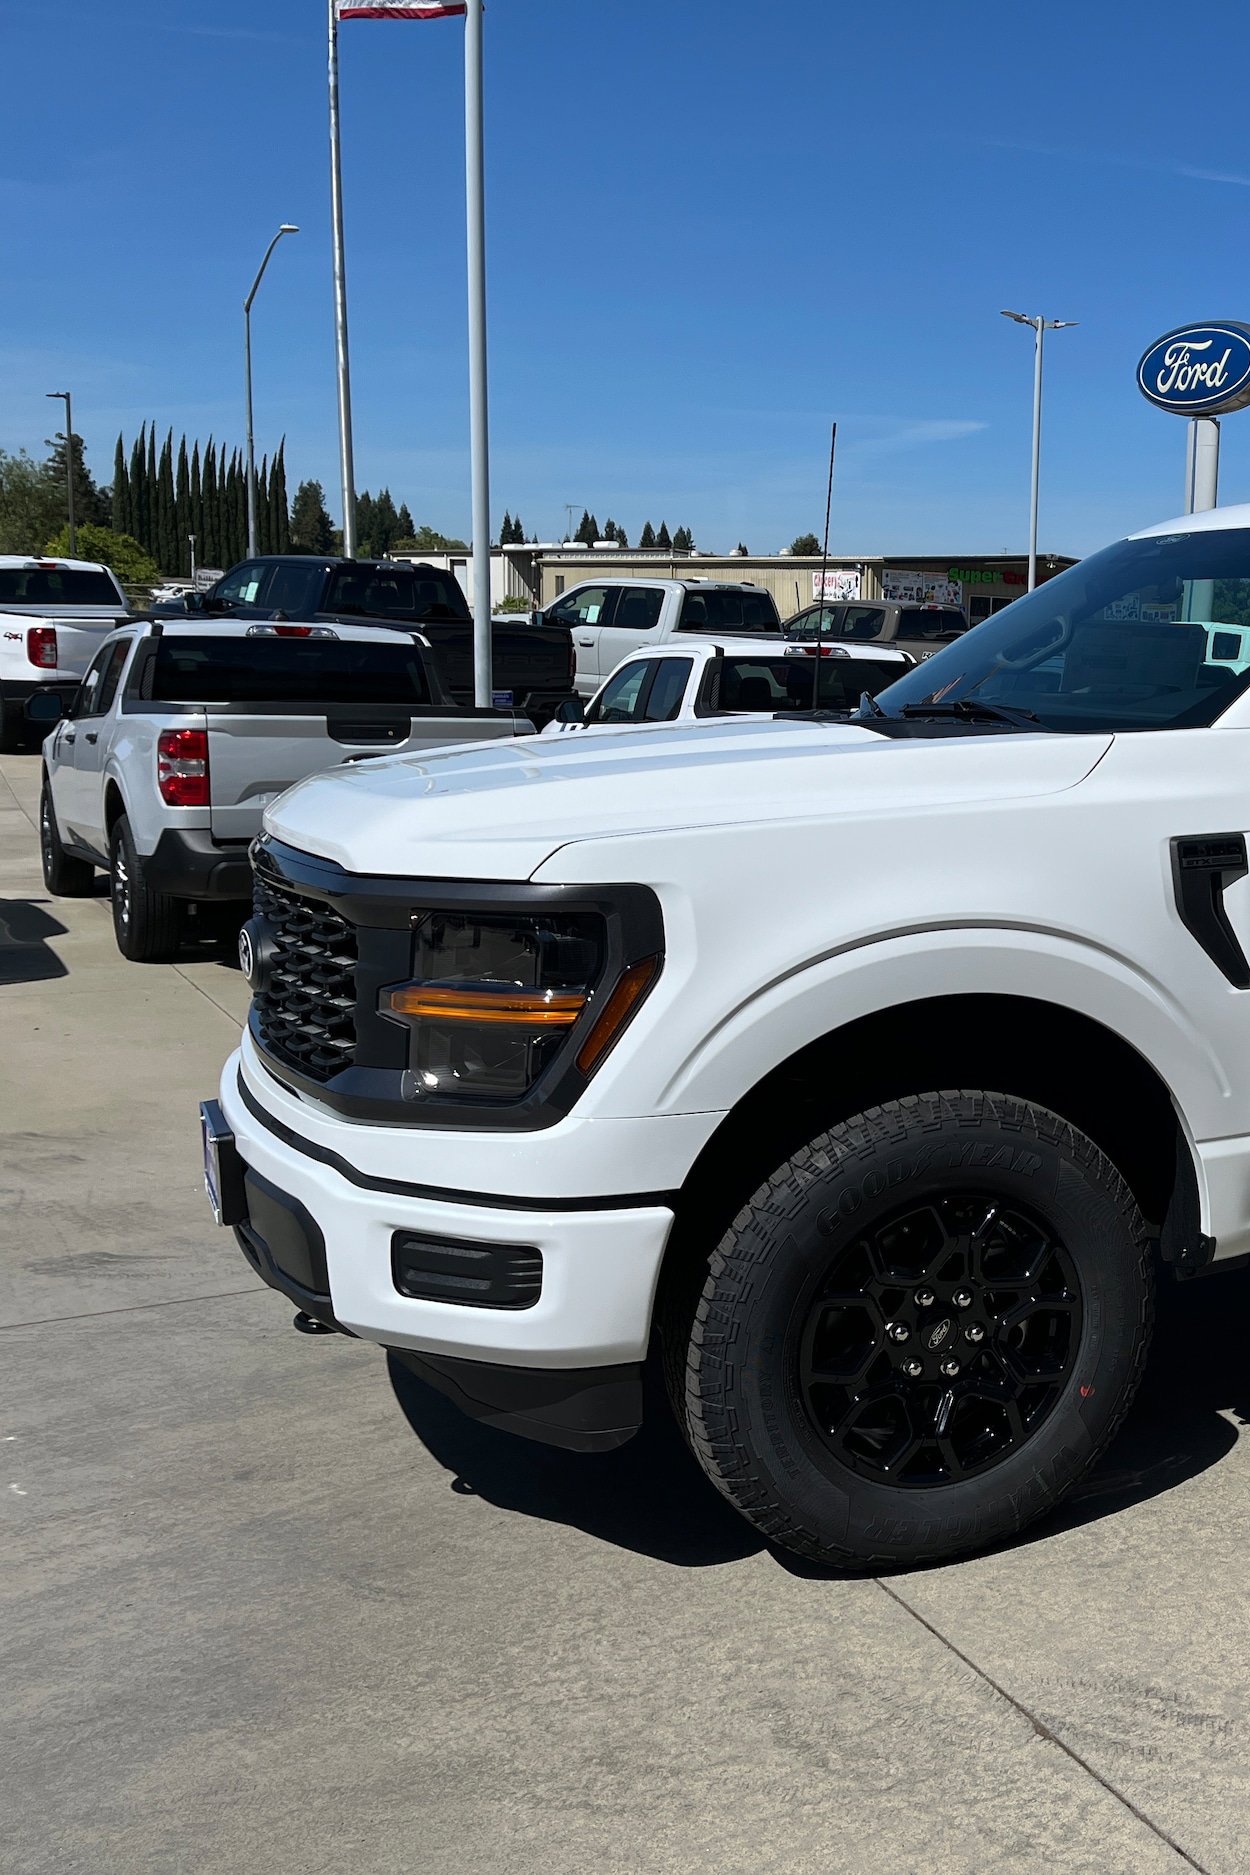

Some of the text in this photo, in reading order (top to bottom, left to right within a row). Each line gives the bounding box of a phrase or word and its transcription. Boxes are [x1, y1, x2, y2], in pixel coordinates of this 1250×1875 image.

[1157, 339, 1232, 394] Ford
[948, 567, 1002, 584] Super
[815, 1140, 1044, 1237] GOODYEAR
